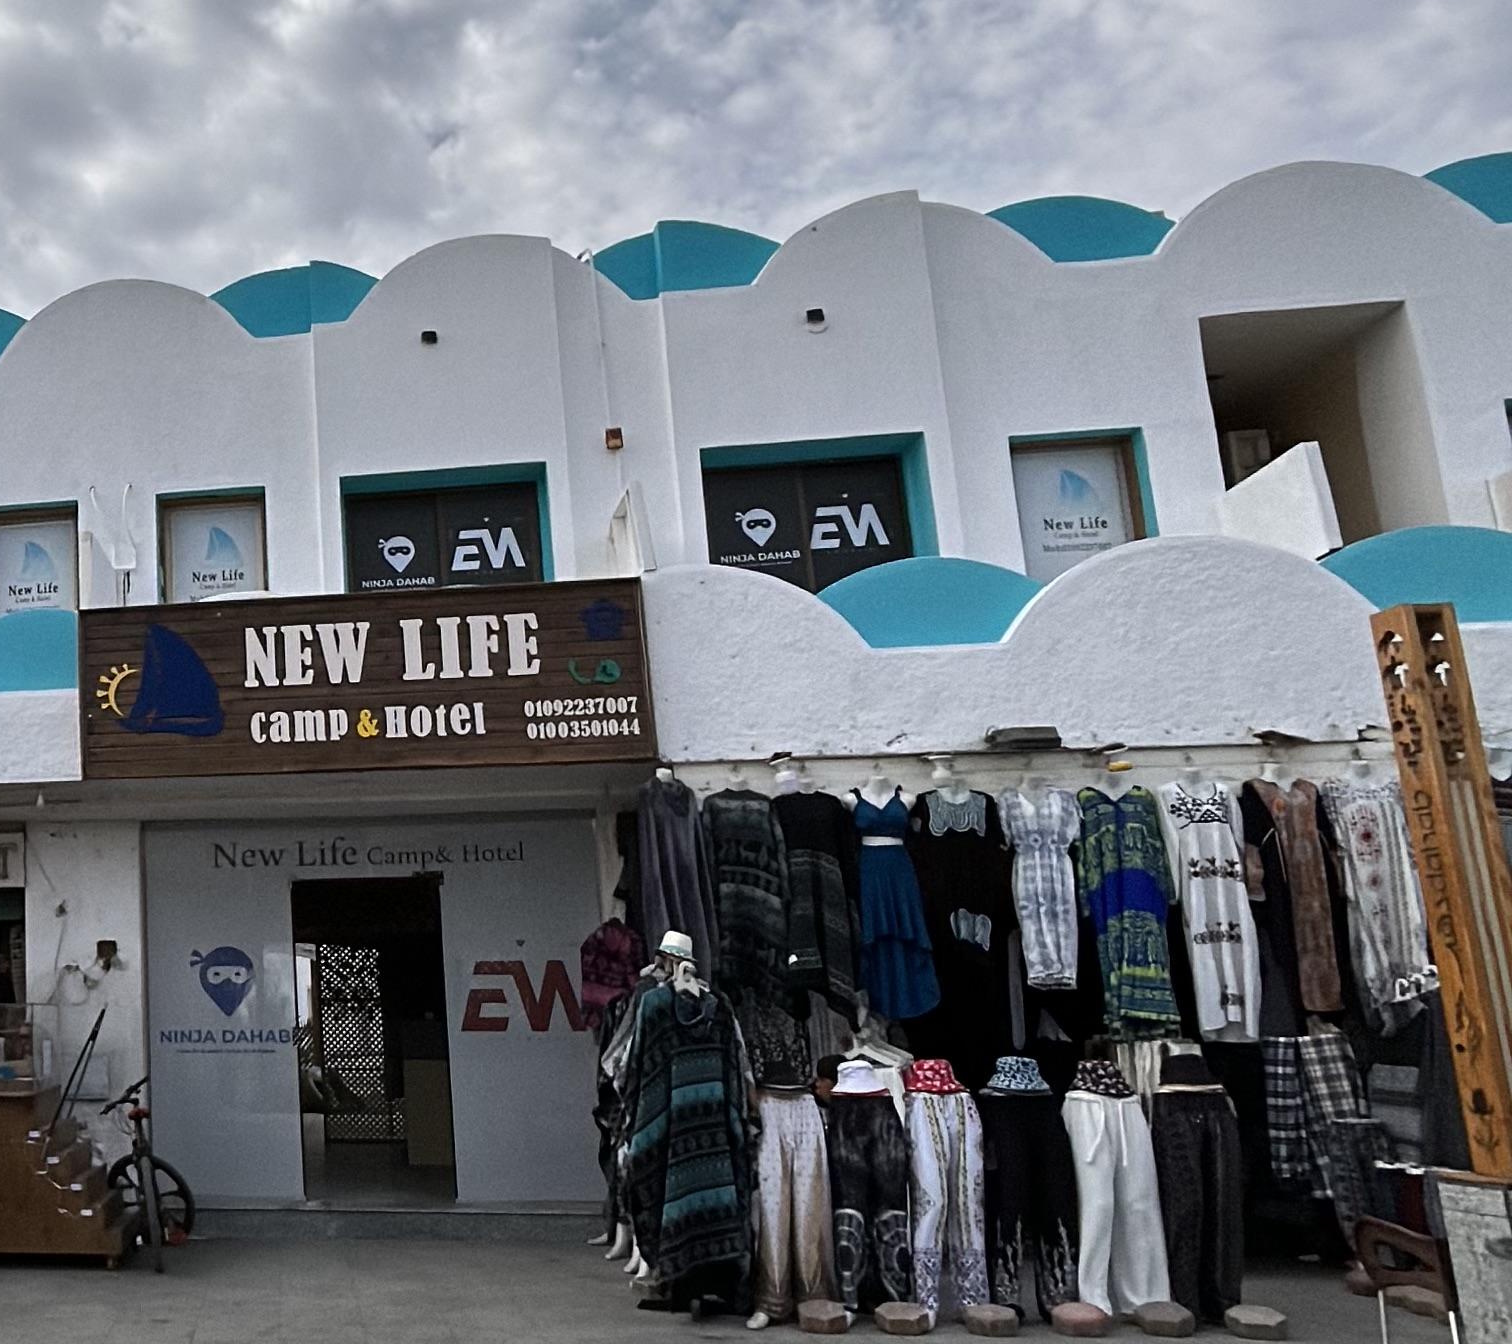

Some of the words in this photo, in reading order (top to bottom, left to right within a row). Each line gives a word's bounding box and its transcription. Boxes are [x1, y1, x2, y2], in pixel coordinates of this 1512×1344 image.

[1043, 518, 1074, 530] New
[1080, 516, 1108, 529] Life
[720, 553, 755, 564] NINJA
[758, 550, 801, 561] DAHAB
[192, 571, 217, 583] New
[222, 569, 245, 581] Life
[362, 579, 394, 588] NINJA
[397, 577, 436, 586] DAHAB
[8, 585, 32, 596] New
[37, 582, 59, 593] Life
[244, 622, 370, 688] NEW
[400, 613, 541, 680] LIFE
[524, 696, 638, 717] 01092237007
[357, 709, 379, 738] &
[385, 702, 486, 738] Hotel
[527, 718, 641, 739] 01003501044
[213, 841, 285, 868] New
[296, 836, 358, 867] Life
[462, 840, 525, 863] Hotel
[160, 1029, 216, 1044] NINJA
[221, 1028, 291, 1043] DAHAB
